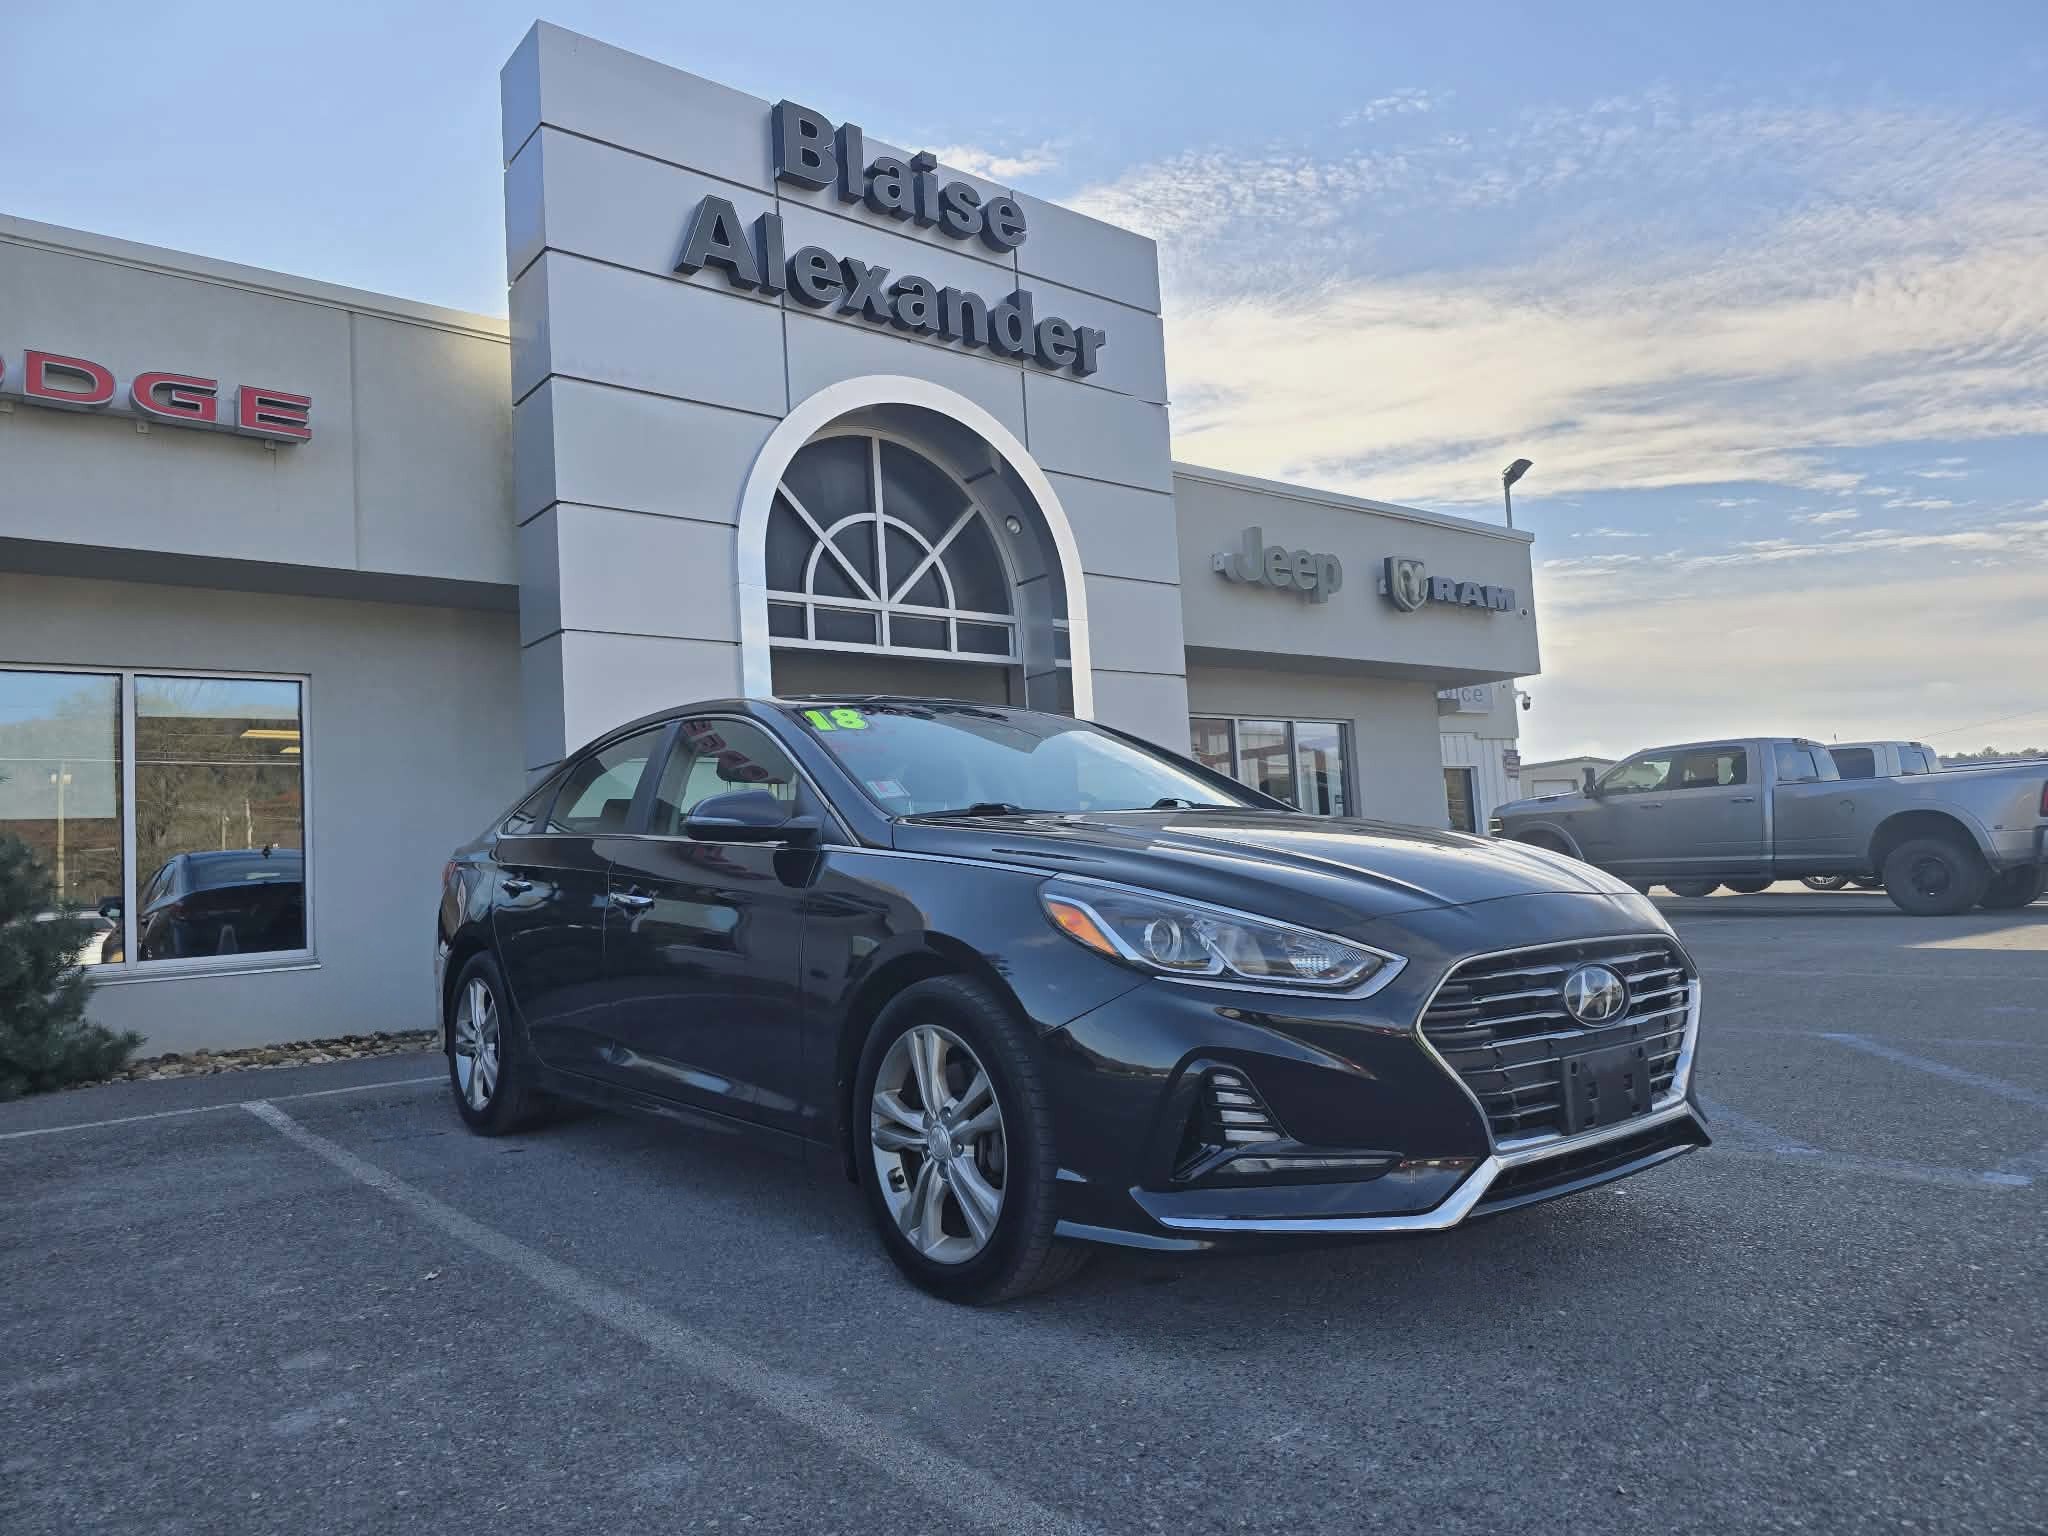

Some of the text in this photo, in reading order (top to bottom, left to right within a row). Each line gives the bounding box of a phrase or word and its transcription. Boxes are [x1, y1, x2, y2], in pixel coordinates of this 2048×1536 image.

[772, 100, 1027, 253] Blaise
[674, 194, 1106, 377] Alexander
[0, 349, 312, 442] DGE
[1222, 526, 1343, 604] Jeep
[1427, 575, 1516, 612] RAM
[804, 709, 869, 730] 18
